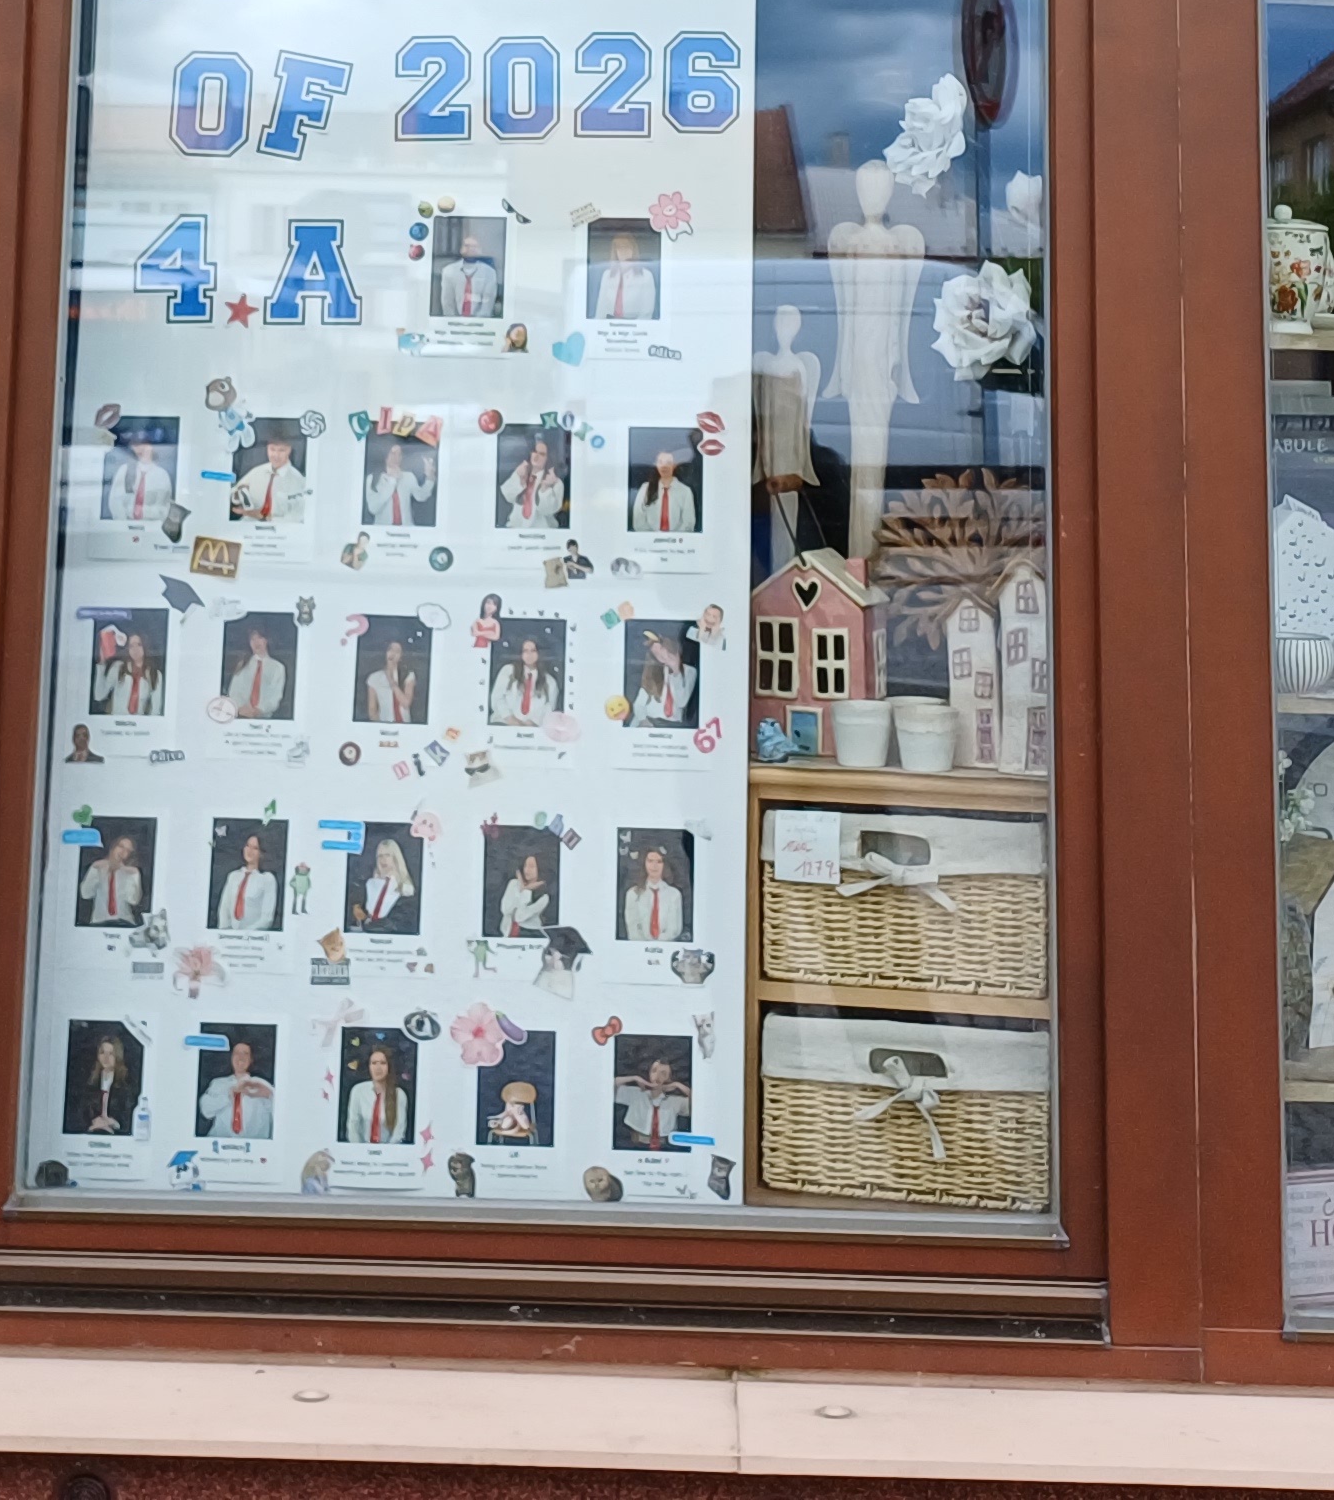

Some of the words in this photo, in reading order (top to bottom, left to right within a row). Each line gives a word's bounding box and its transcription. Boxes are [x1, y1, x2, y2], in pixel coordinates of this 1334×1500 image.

[169, 50, 353, 160] OF
[394, 30, 741, 142] 2026
[134, 213, 217, 324] 4
[264, 218, 363, 326] A
